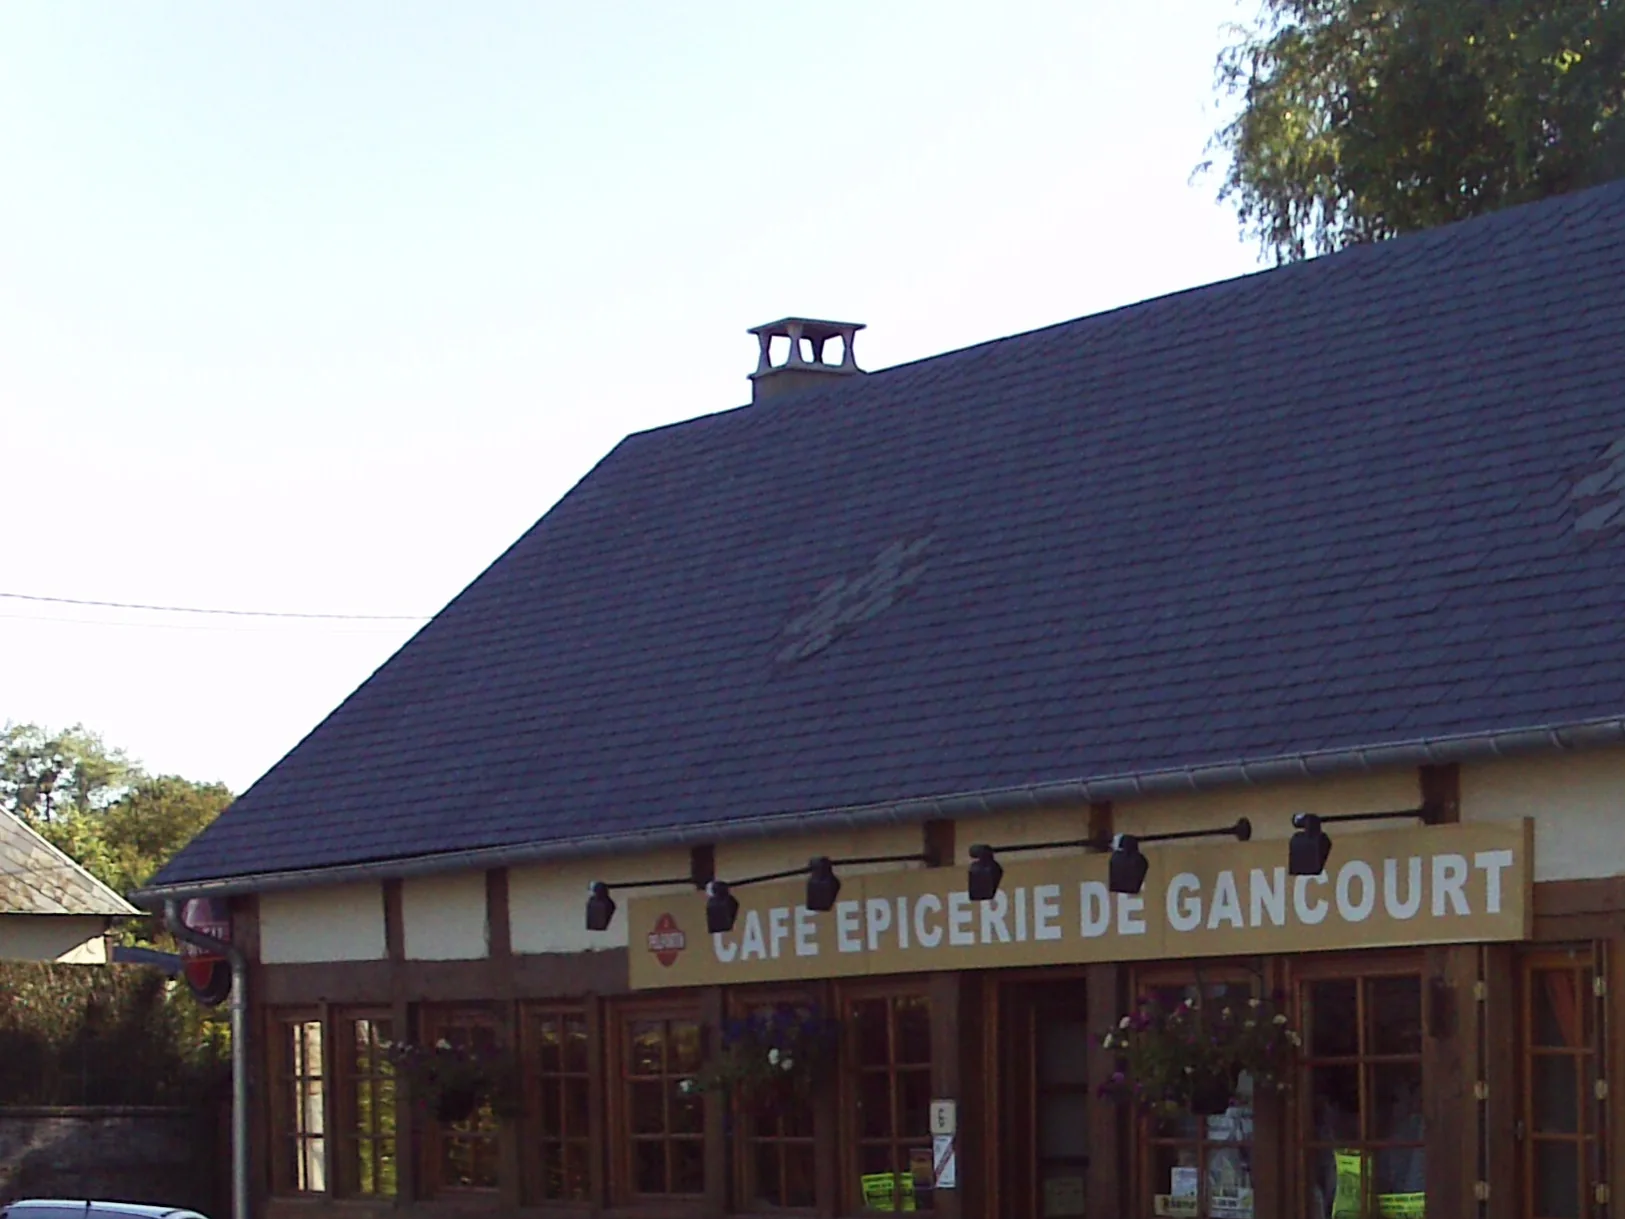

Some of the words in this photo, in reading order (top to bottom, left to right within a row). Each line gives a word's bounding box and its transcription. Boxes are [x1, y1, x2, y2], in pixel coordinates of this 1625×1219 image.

[713, 904, 818, 963] CAFE
[838, 884, 1062, 954] EPICERIE
[1080, 880, 1146, 938] DE
[1166, 850, 1513, 933] GANCOURT
